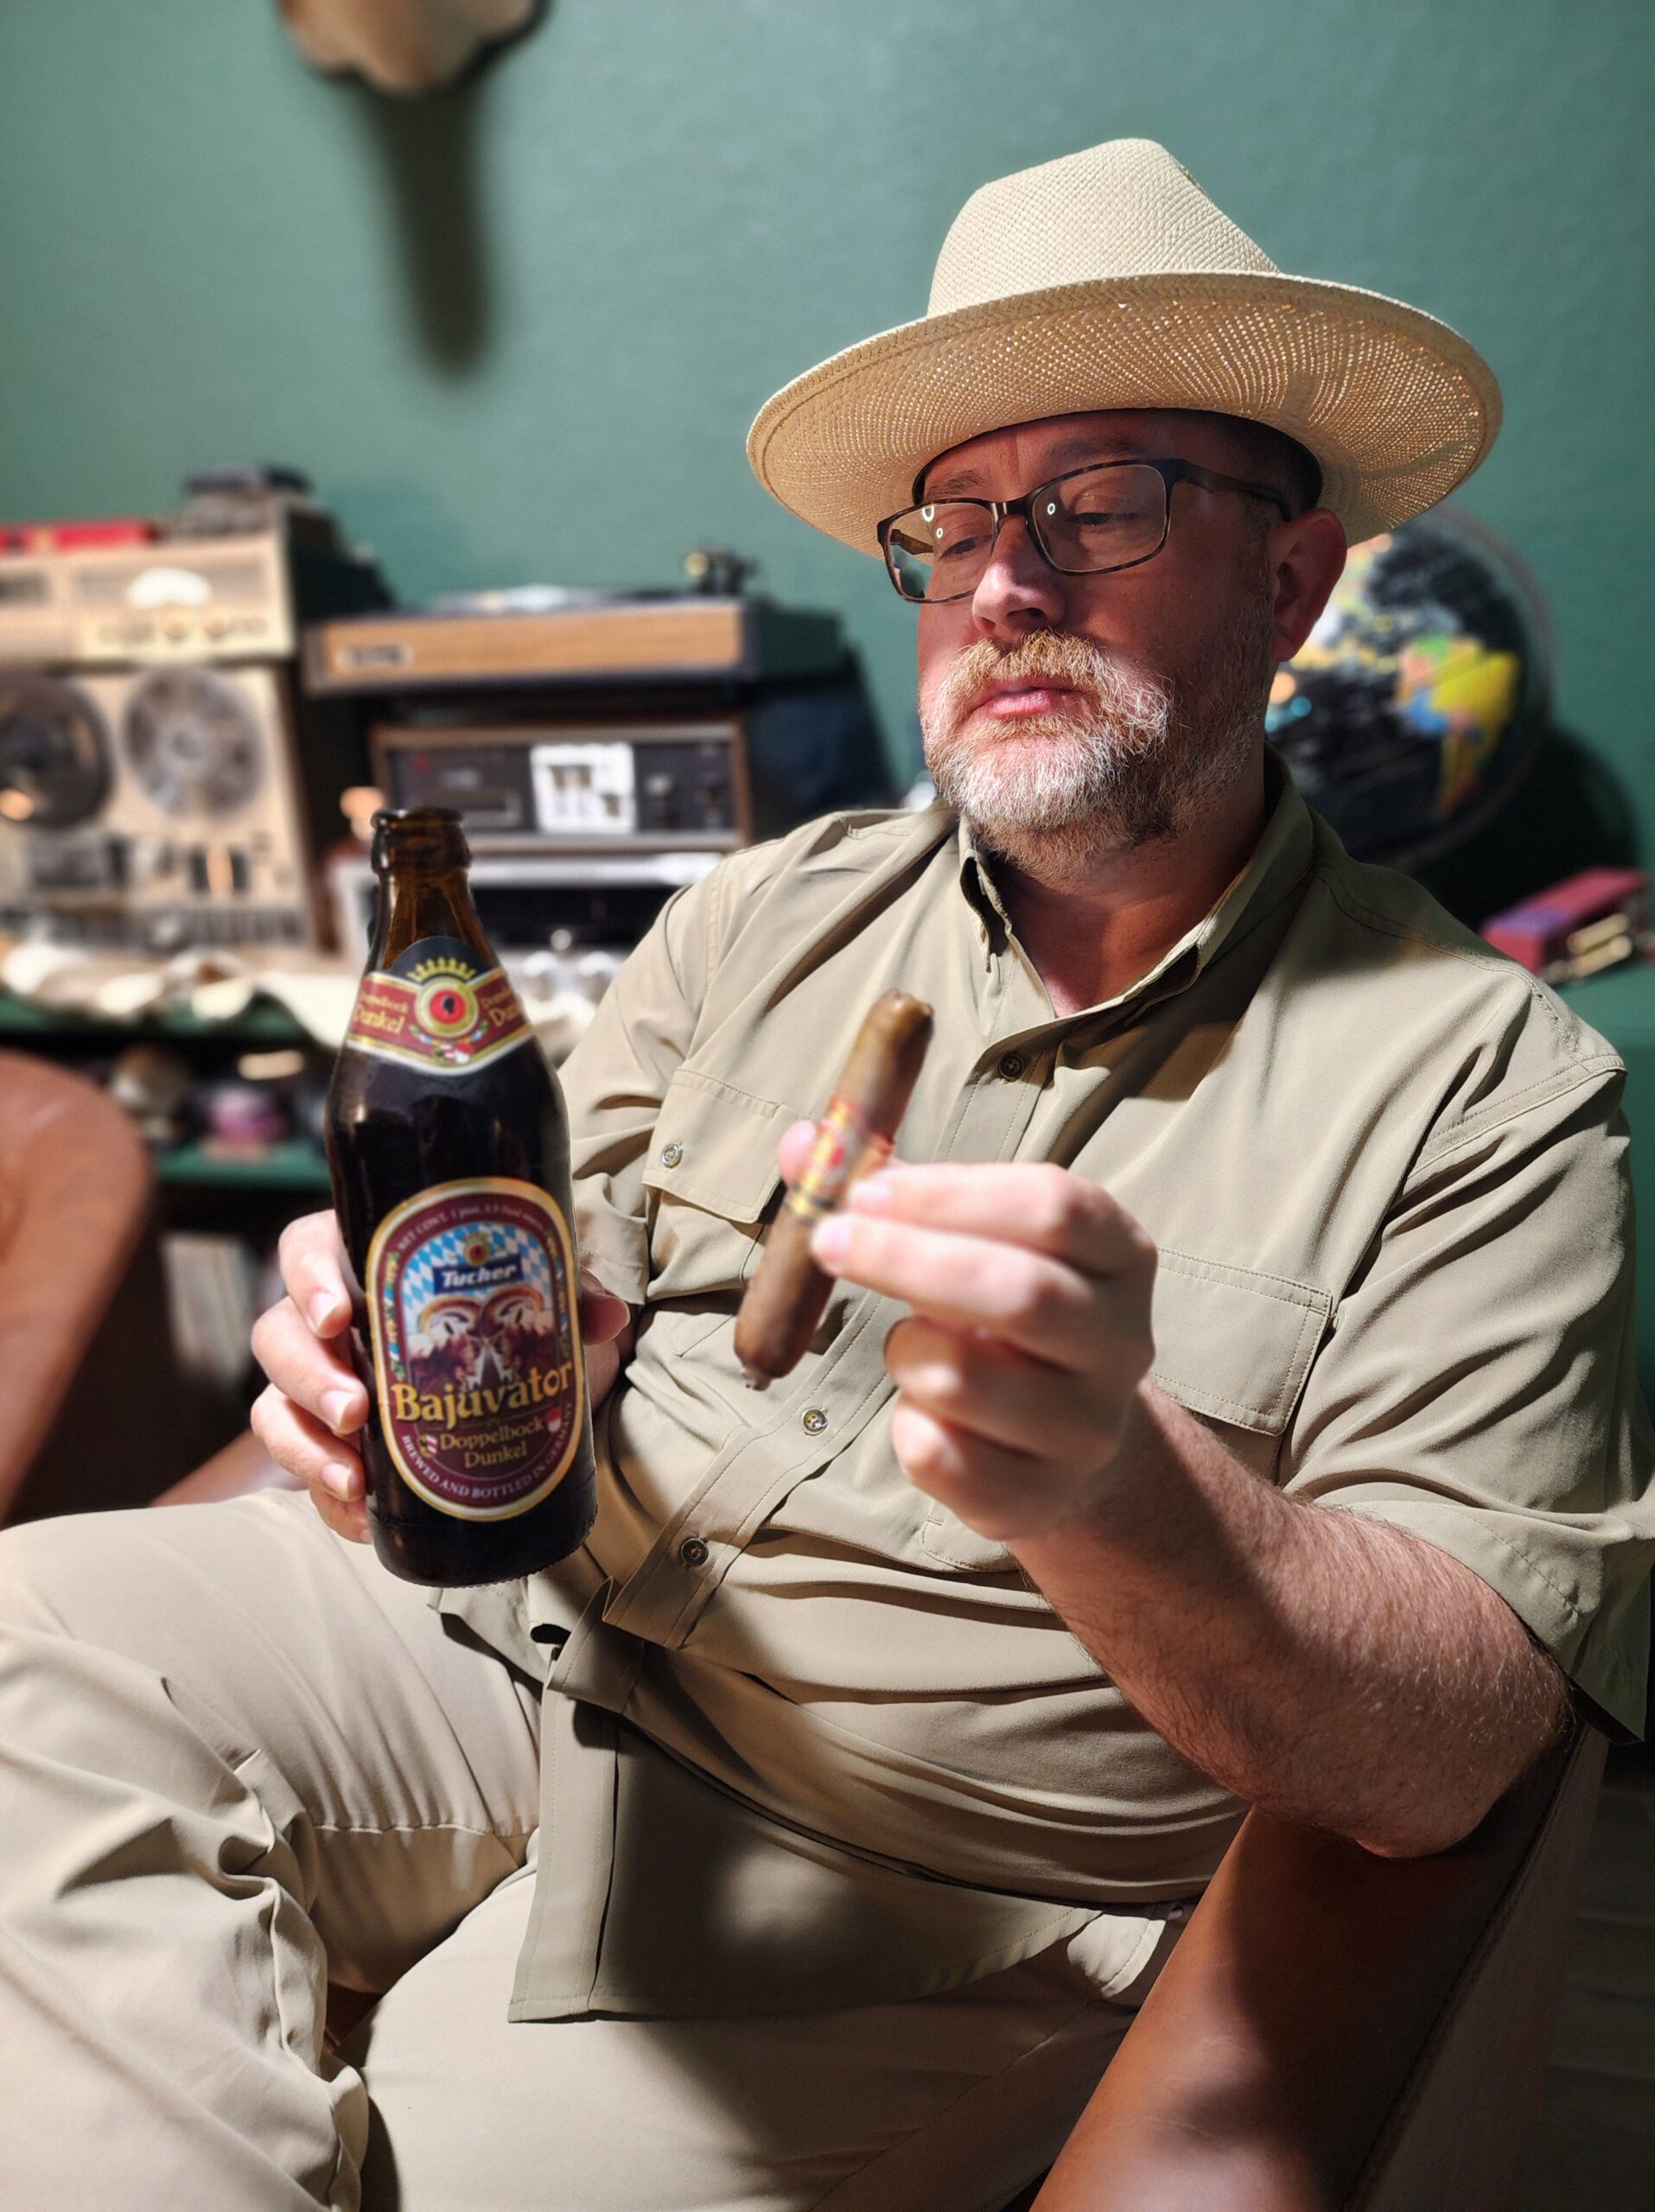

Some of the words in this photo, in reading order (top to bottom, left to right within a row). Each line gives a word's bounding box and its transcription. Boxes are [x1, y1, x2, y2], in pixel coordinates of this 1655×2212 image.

[441, 1265, 517, 1288] Tucher
[390, 1361, 573, 1430] Bajuvator
[439, 1415, 544, 1451] Doppelbock
[402, 1434, 441, 1484] BREWED
[441, 1478, 470, 1497] AND
[471, 1474, 533, 1499] BOTTLED
[532, 1465, 546, 1479] IN
[463, 1440, 528, 1469] Dunkel
